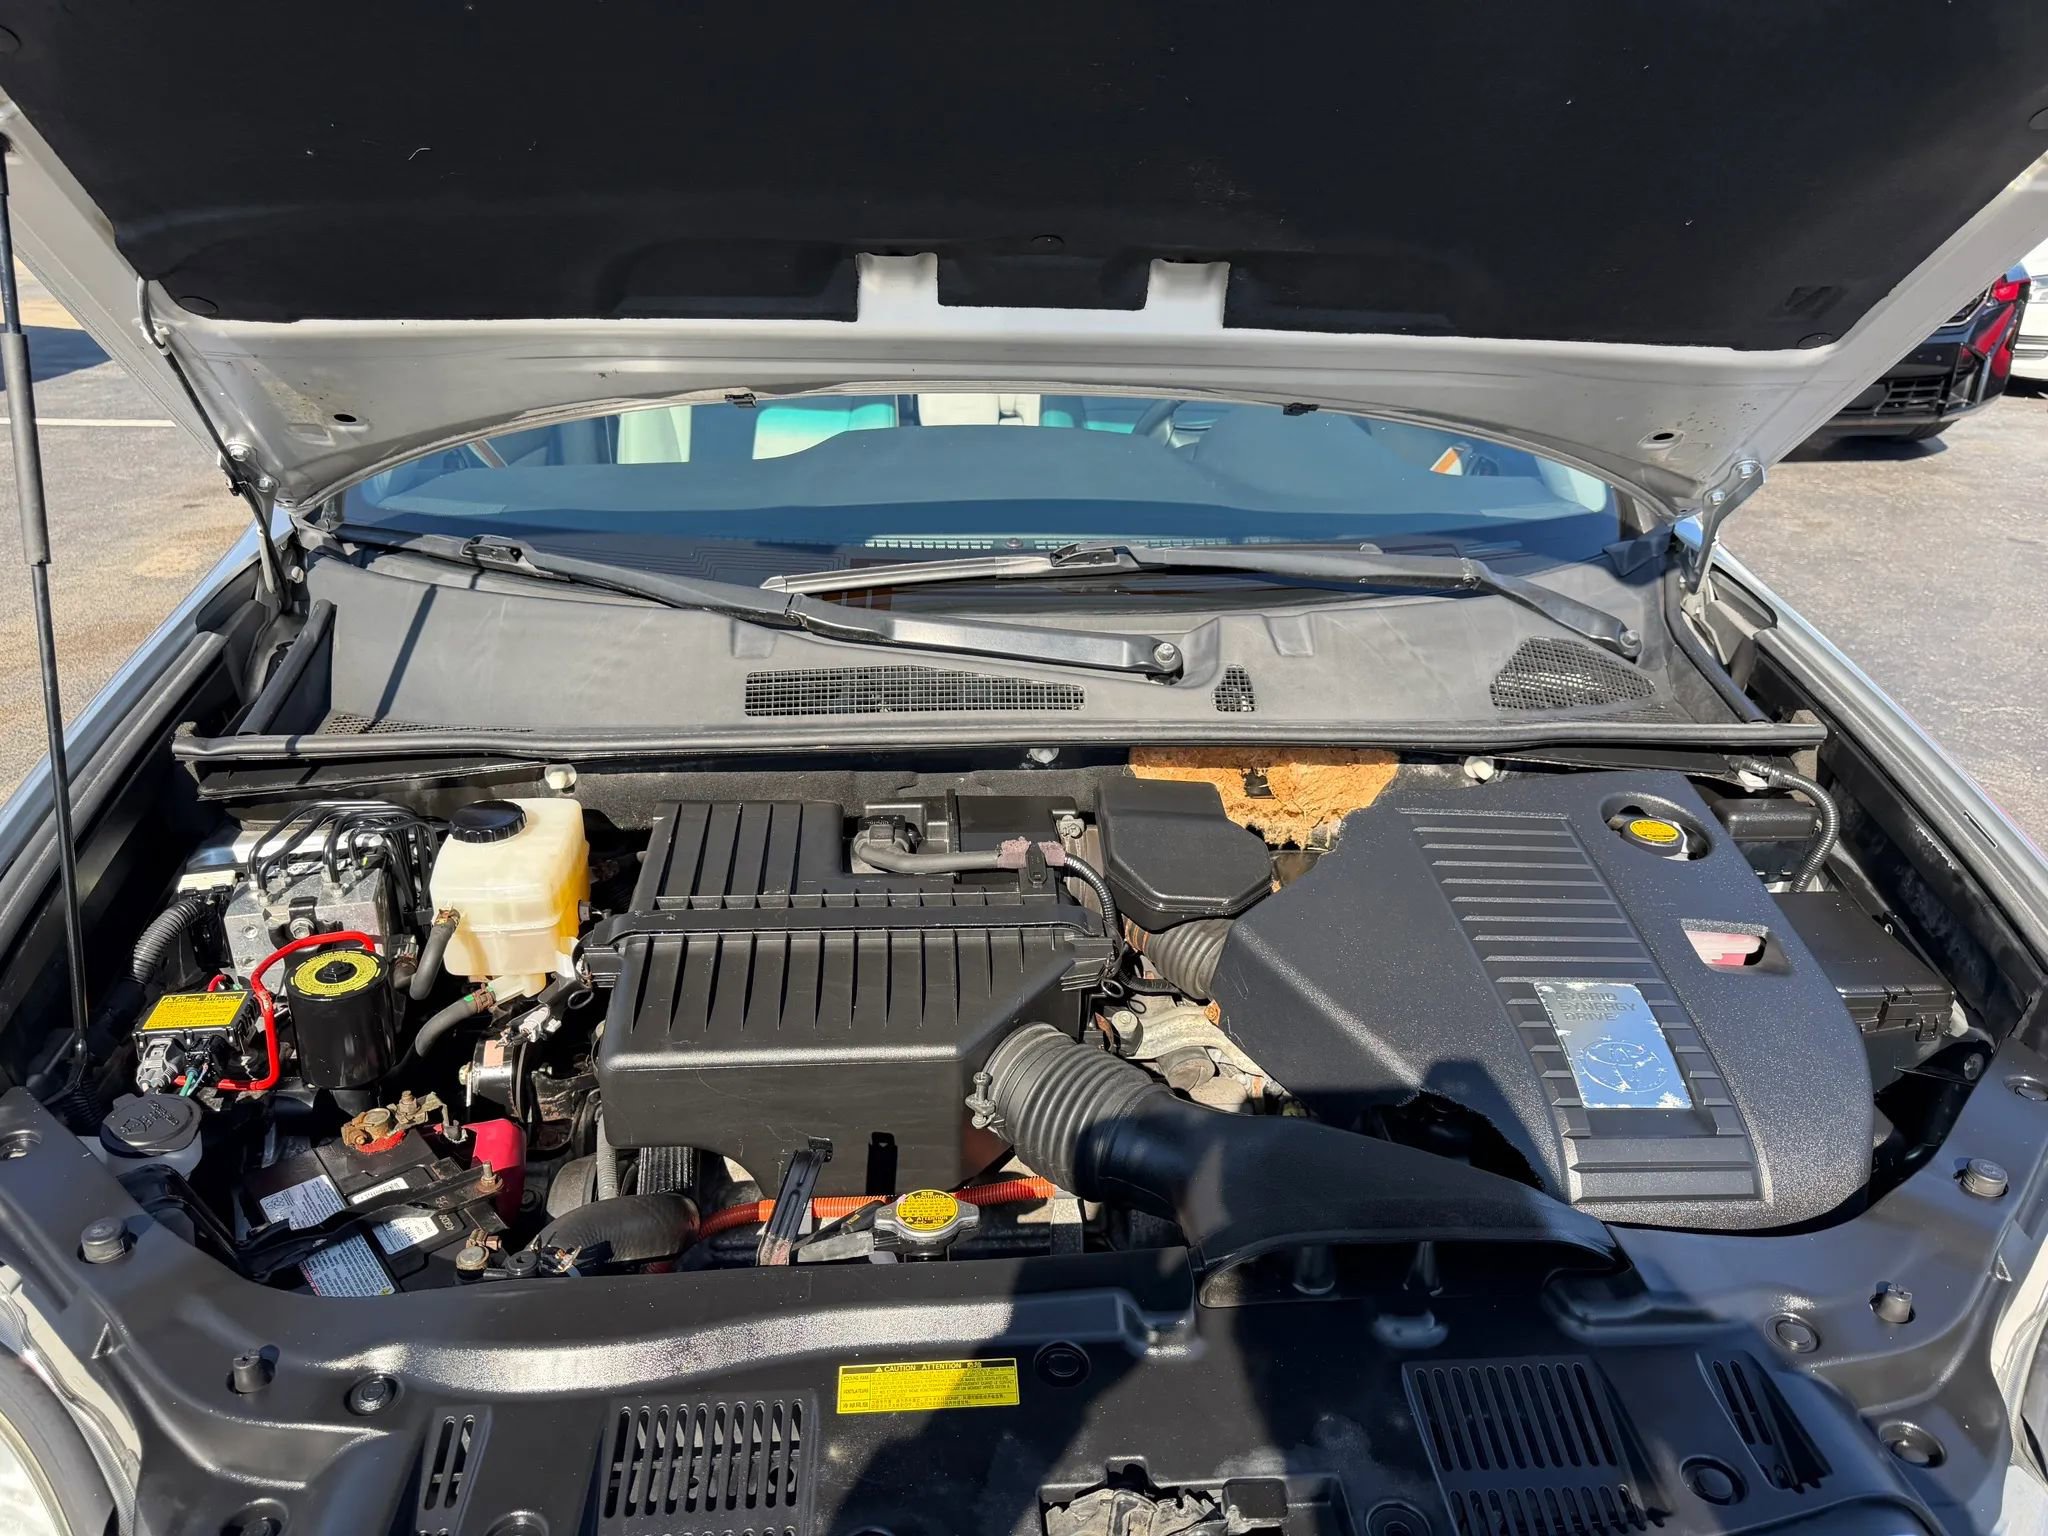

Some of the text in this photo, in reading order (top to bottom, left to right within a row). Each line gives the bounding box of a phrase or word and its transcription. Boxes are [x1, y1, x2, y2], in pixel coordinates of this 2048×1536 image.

[1556, 992, 1617, 1001] HYBRID
[1559, 1002, 1636, 1012] SYNERGY
[1564, 1012, 1617, 1021] DRIVE
[884, 1362, 962, 1372] CAUTION ATTENTION
